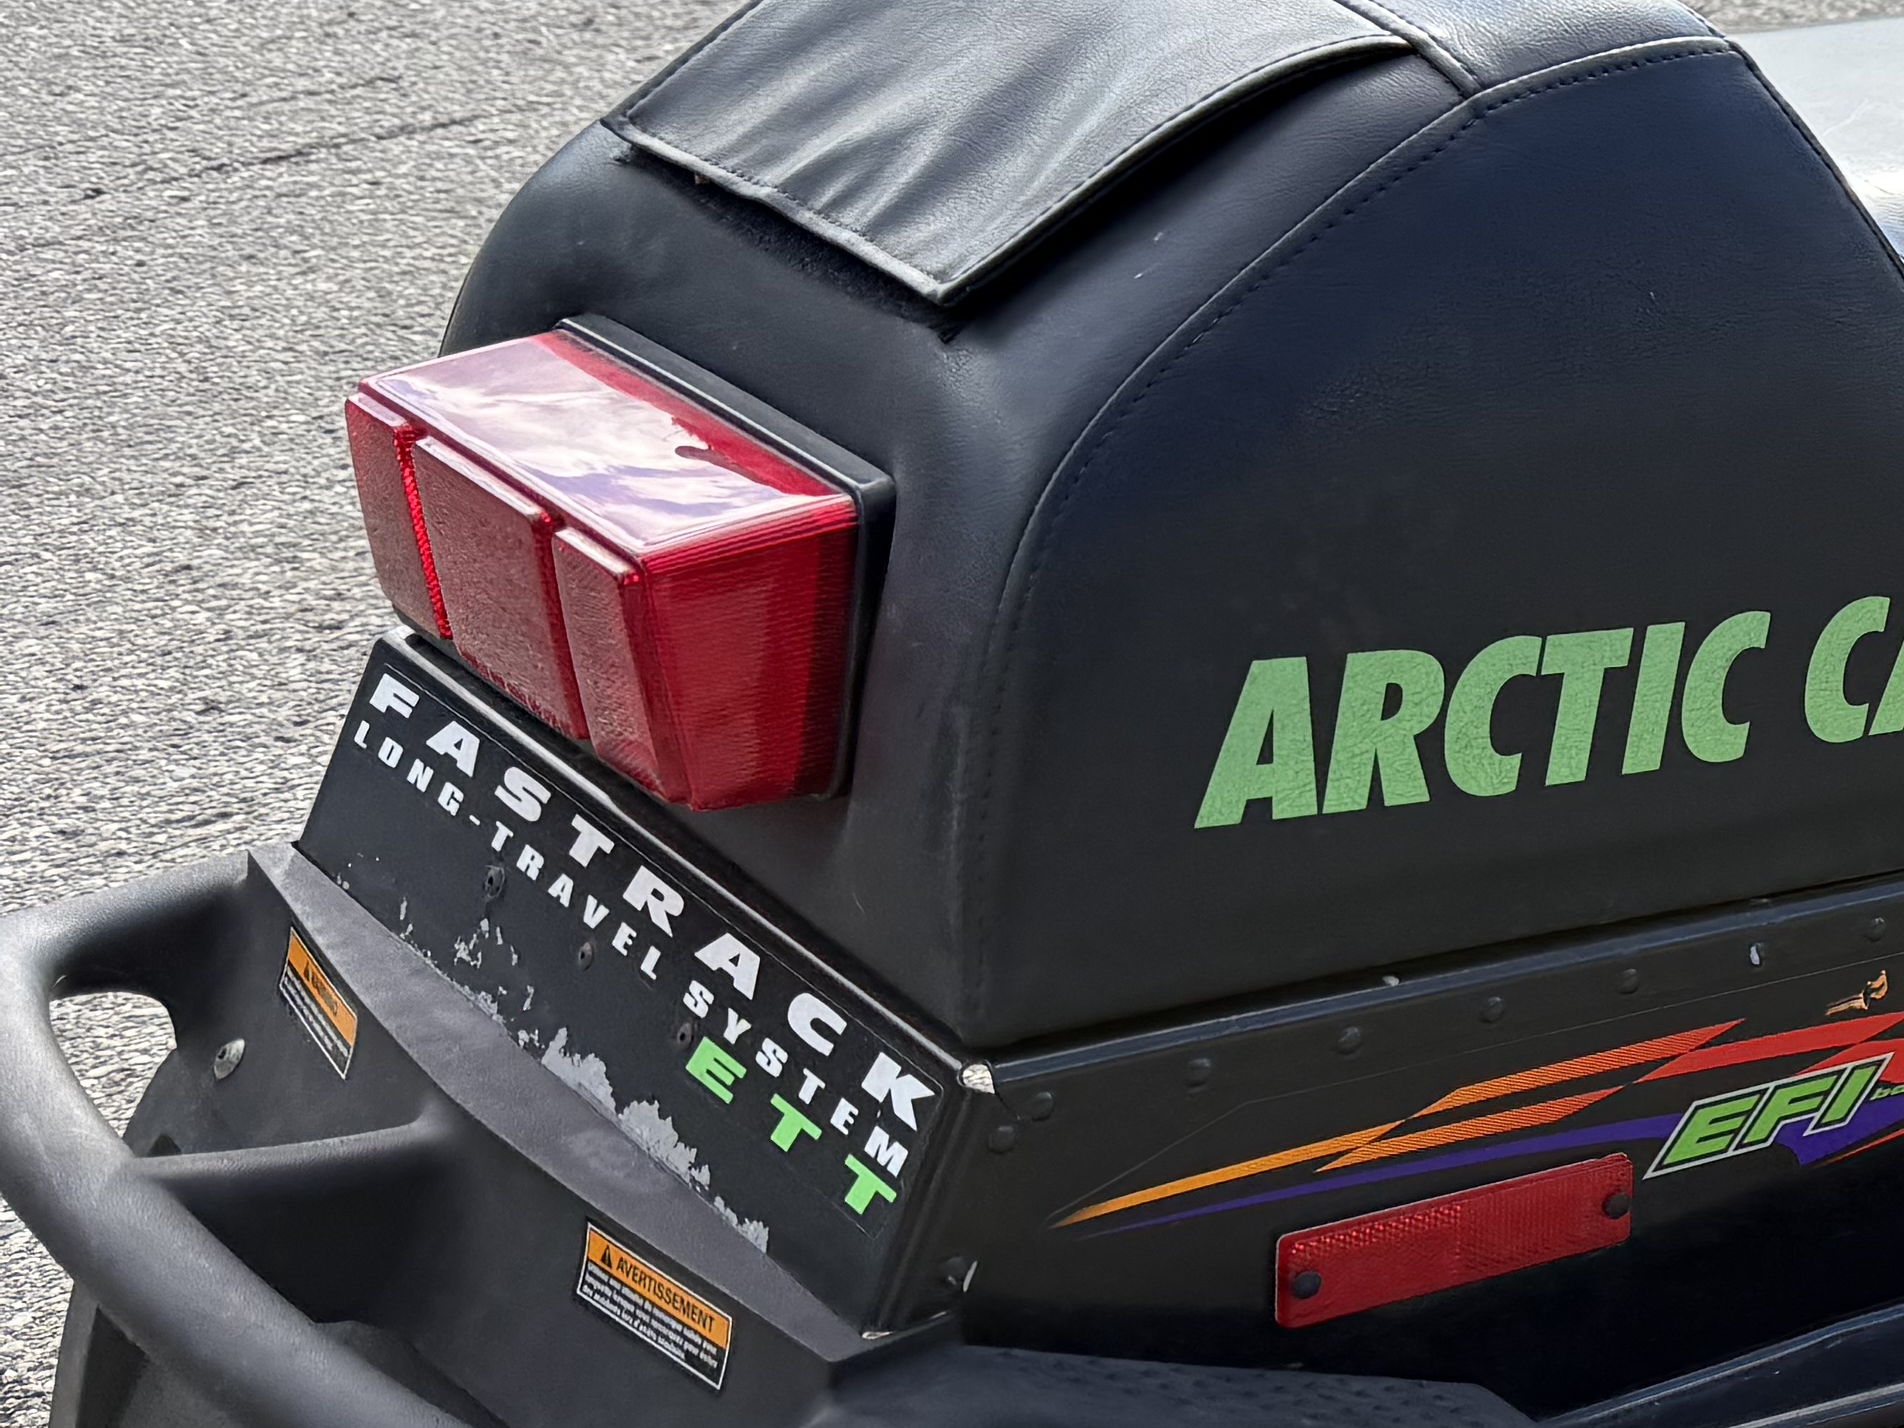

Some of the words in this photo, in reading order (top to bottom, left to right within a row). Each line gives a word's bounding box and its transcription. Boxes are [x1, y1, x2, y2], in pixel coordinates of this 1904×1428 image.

[1194, 610, 1771, 829] ARCTIC
[353, 720, 660, 981] LONG-TRAVEL
[683, 979, 910, 1176] SYSTEM
[369, 673, 937, 1131] FASTRACK
[685, 1036, 897, 1216] ETT
[1648, 1056, 1889, 1175] EFI
[616, 1256, 716, 1333] AVERTISSEMENT
